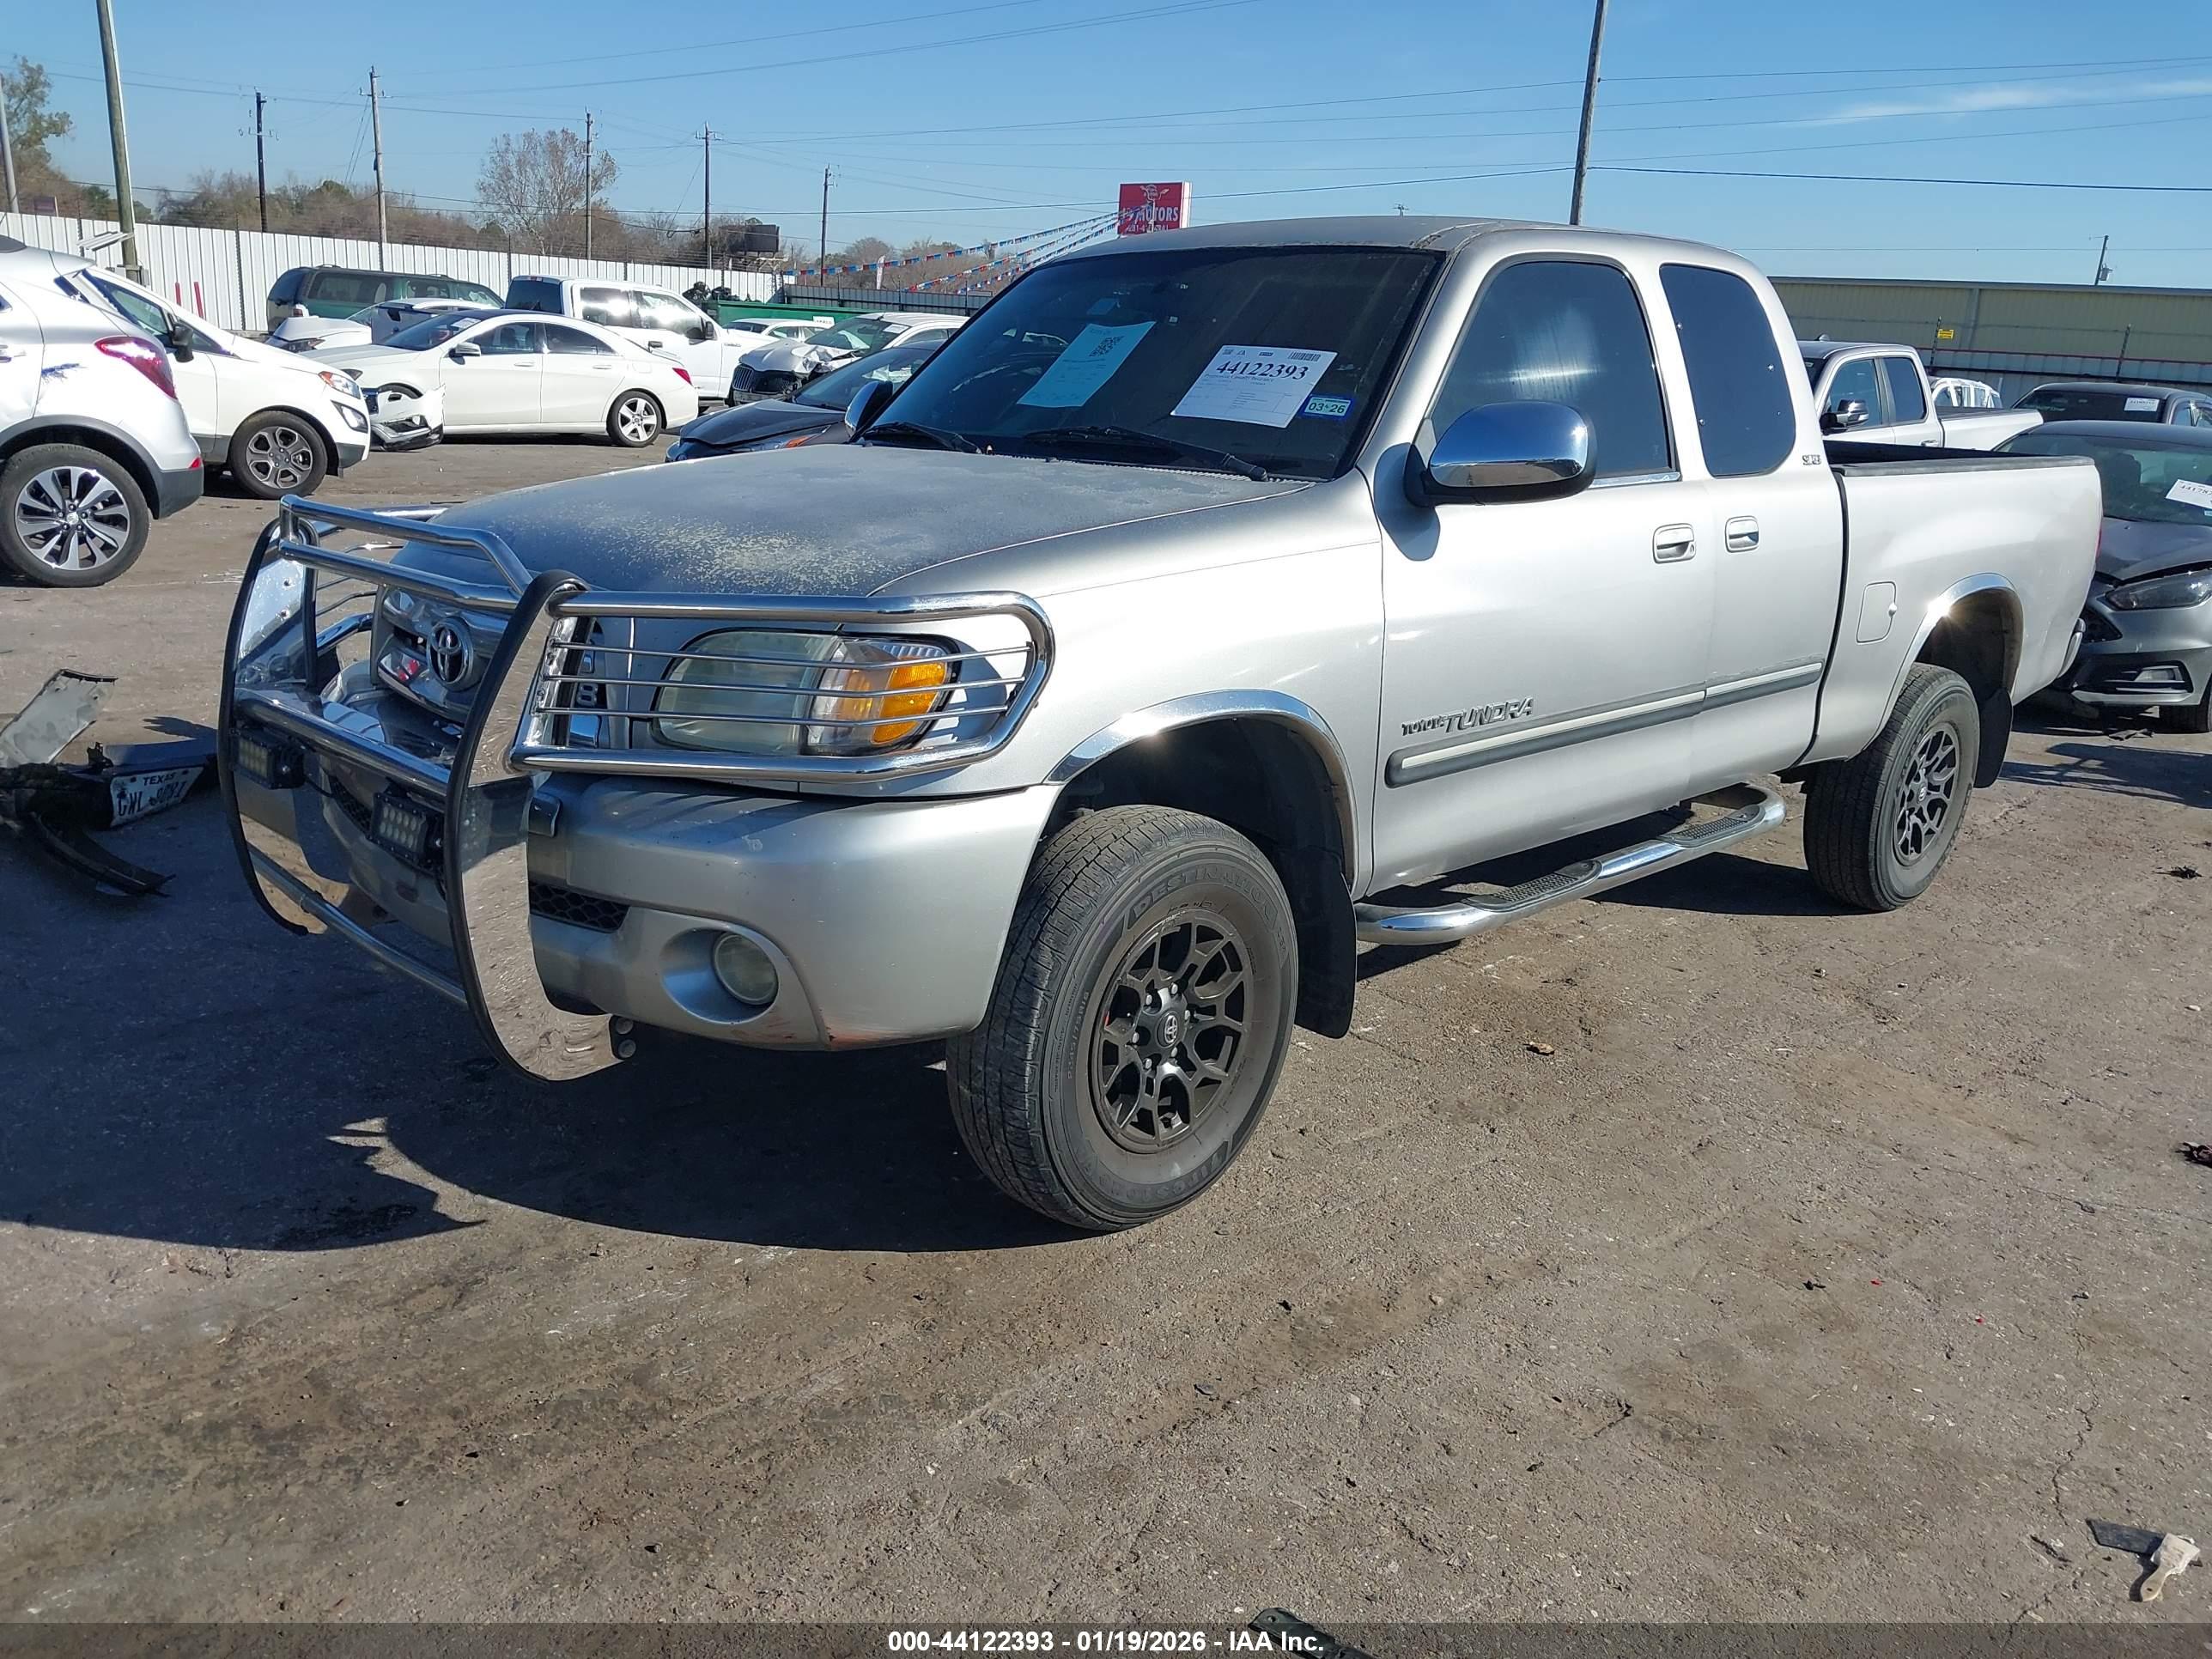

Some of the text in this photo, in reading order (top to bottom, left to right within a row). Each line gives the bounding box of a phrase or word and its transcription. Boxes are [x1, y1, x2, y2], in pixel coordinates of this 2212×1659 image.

[1216, 360, 1310, 380] 44122393
[1308, 403, 1346, 414] 03 26
[1445, 696, 1534, 733] TUNDRA
